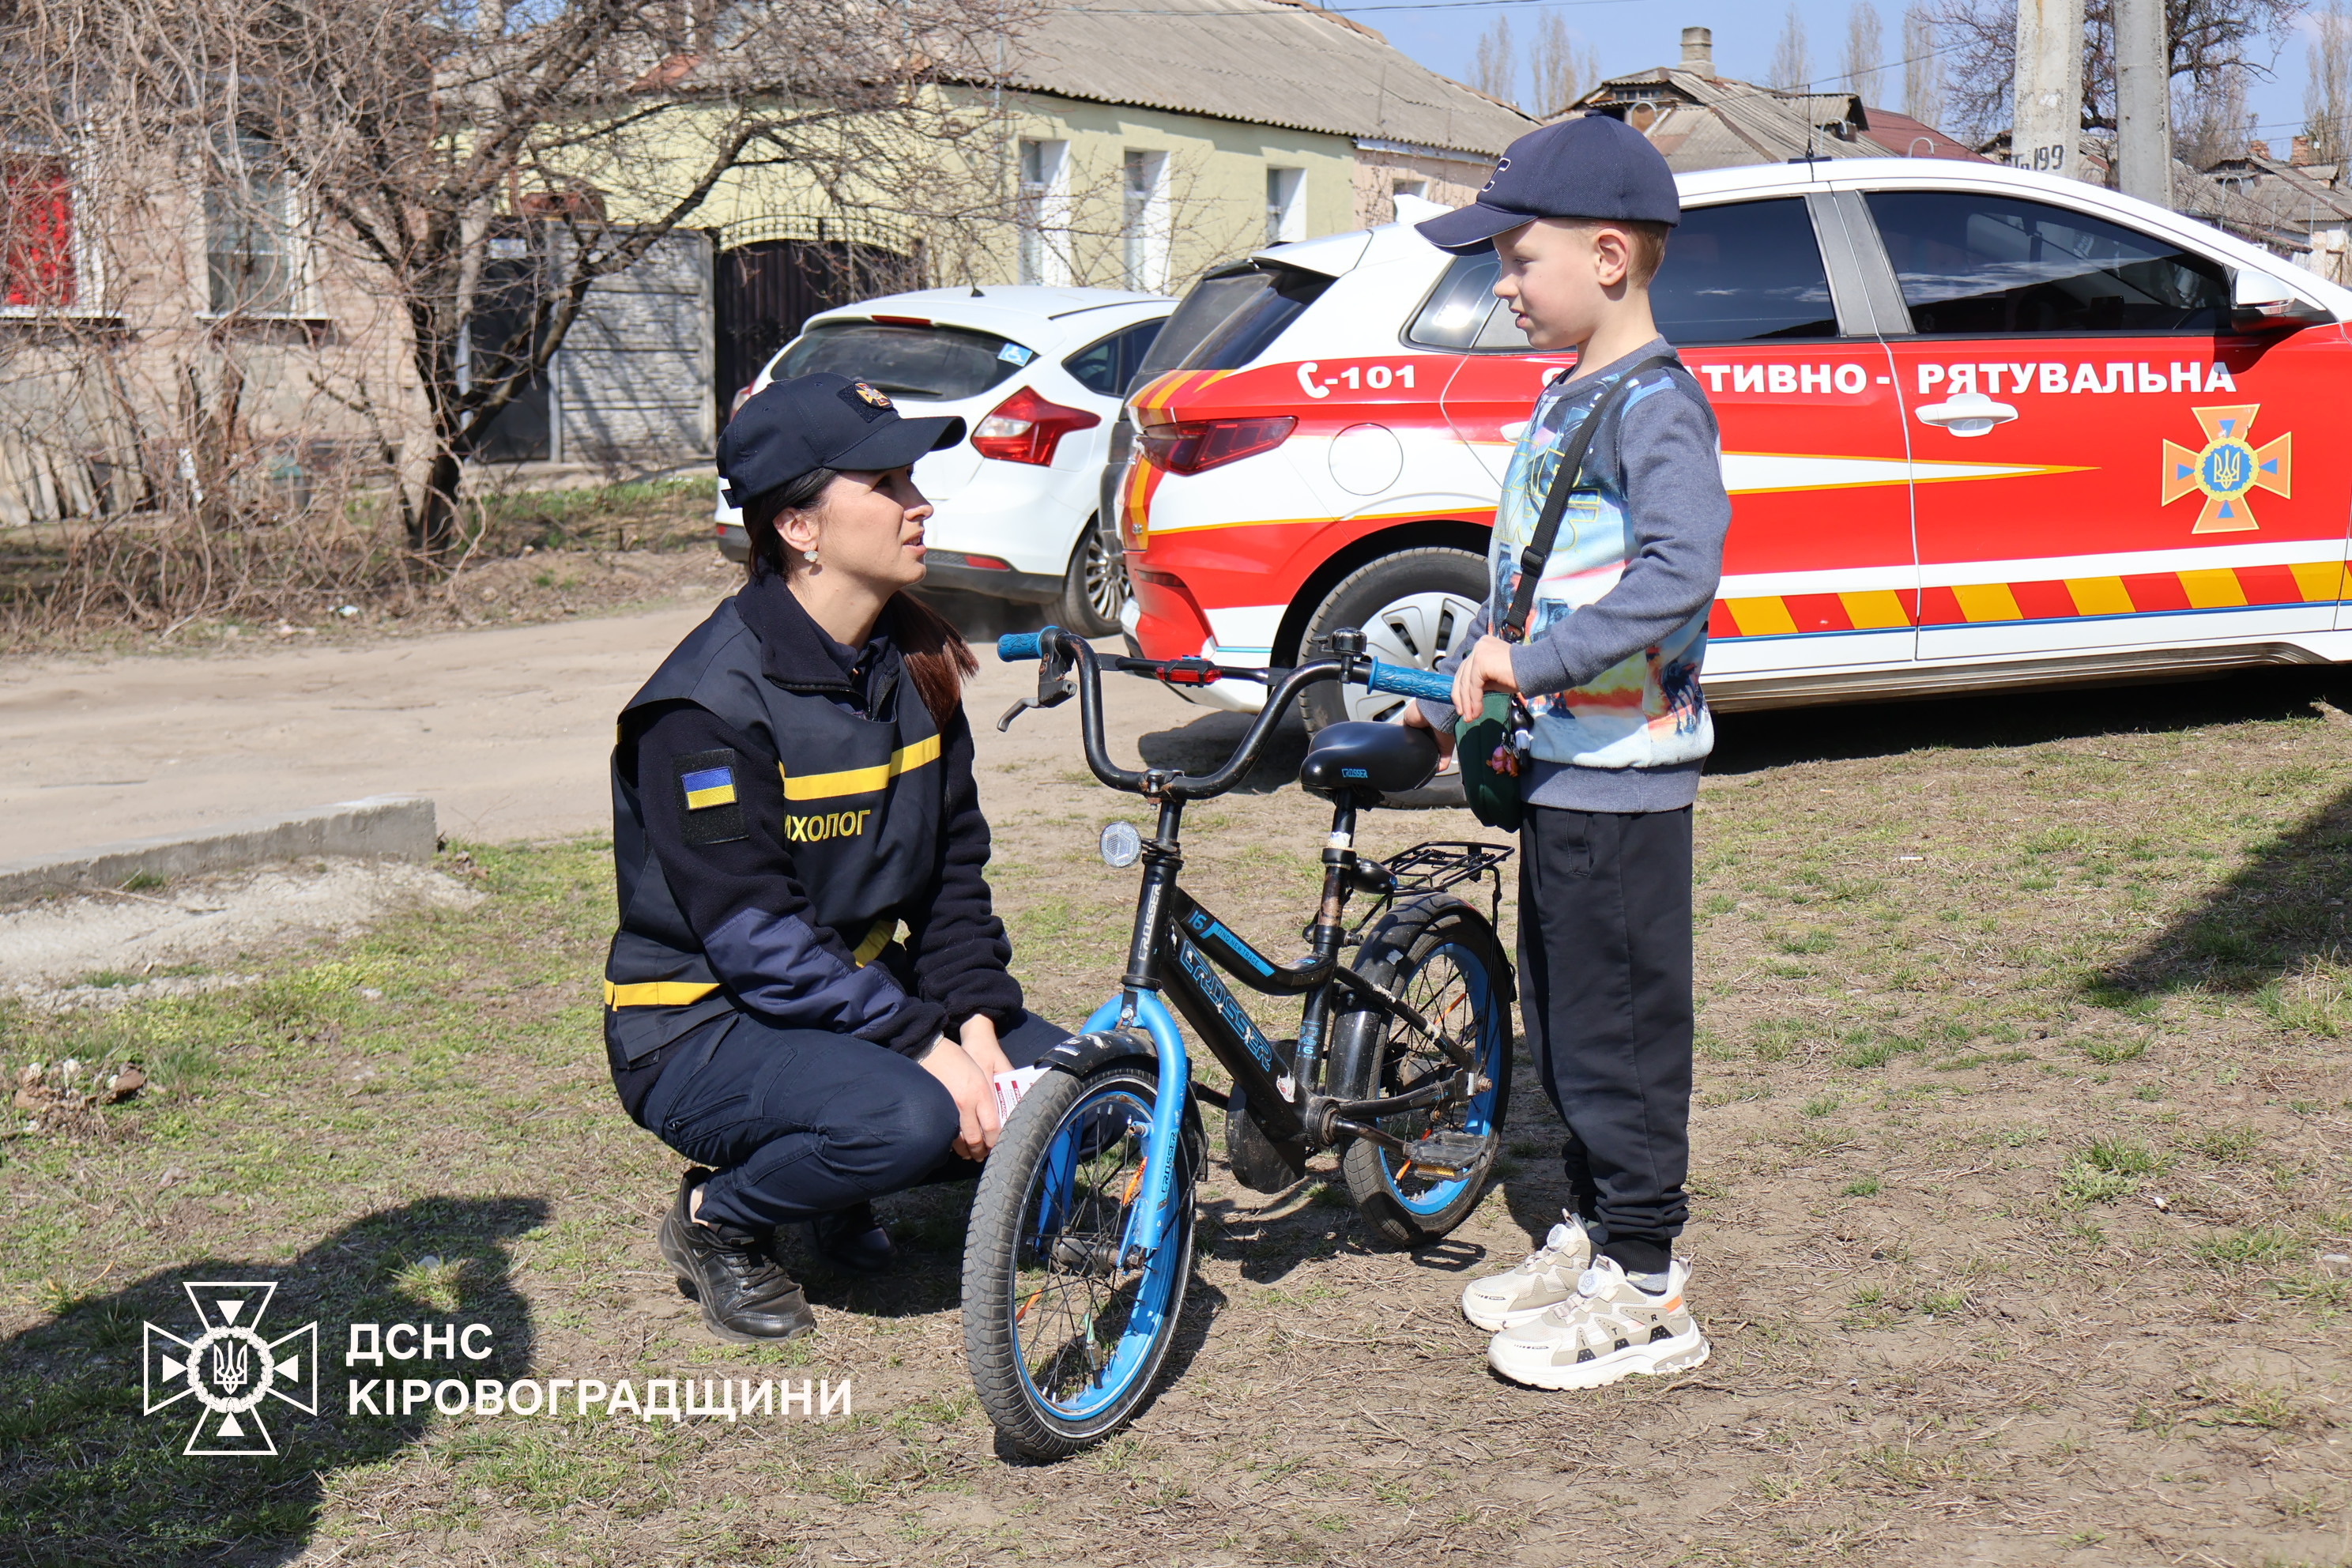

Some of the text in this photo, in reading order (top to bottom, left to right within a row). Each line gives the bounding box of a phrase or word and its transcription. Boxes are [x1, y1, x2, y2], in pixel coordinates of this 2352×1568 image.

[1917, 361, 2237, 394] РЯТУВАЛЬНА
[784, 809, 872, 842] ИХОЛОГ
[1187, 909, 1208, 930] 16
[1216, 927, 1231, 942] FIND
[1230, 940, 1243, 952] NEW
